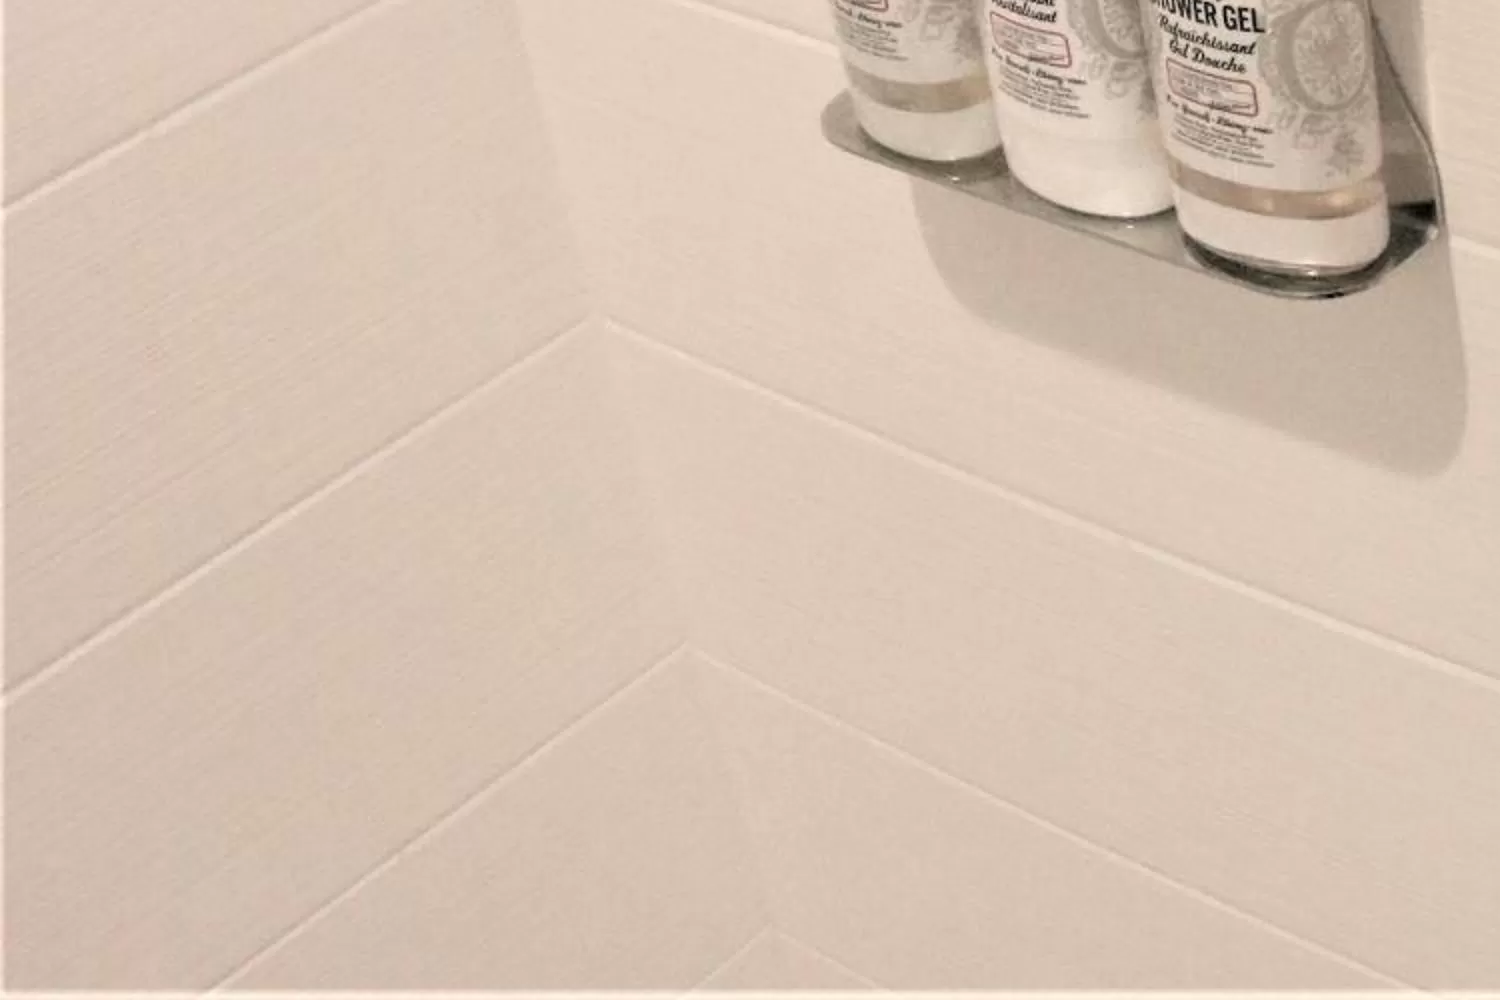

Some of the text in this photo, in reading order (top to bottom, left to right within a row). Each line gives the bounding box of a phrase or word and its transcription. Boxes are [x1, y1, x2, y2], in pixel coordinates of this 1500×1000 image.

[1222, 5, 1266, 34] GEL
[1169, 38, 1247, 74] Gel Douche
